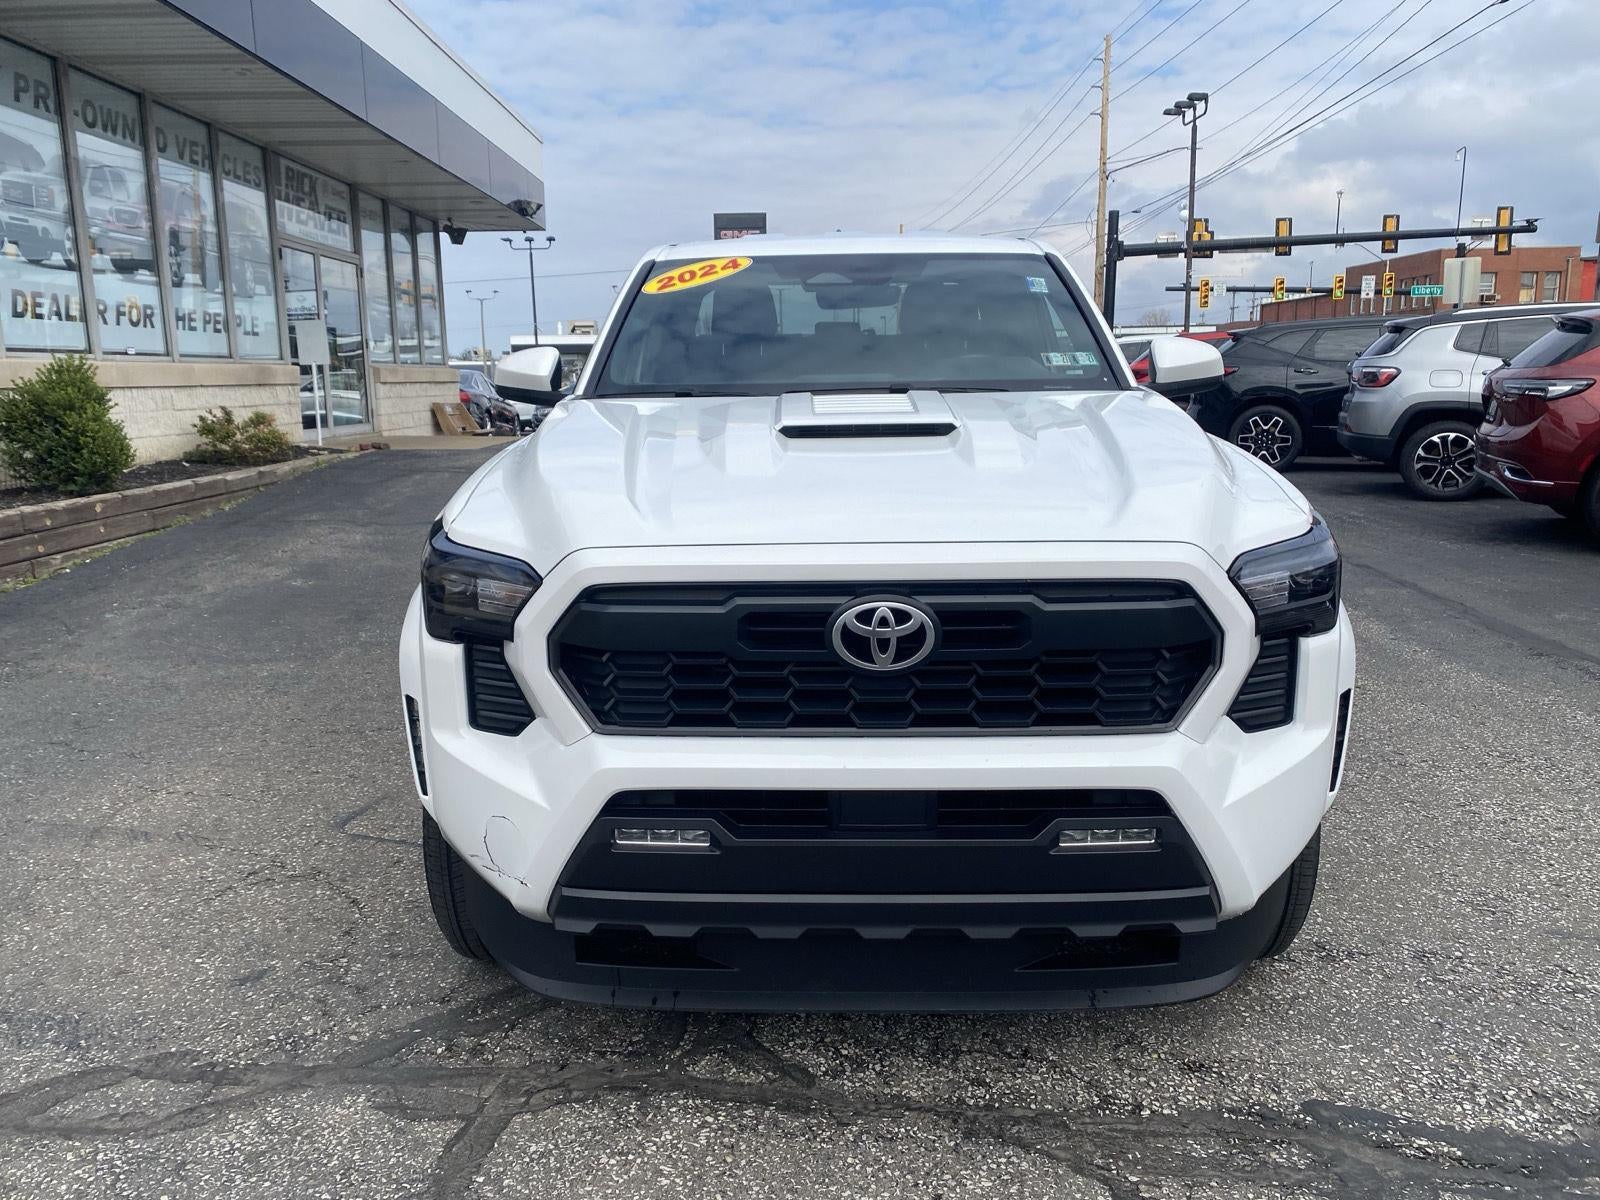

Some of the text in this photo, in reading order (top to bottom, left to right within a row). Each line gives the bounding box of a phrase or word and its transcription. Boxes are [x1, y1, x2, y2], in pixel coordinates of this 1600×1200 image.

[174, 134, 262, 188] VEHCLES
[656, 258, 742, 292] 2024
[1415, 286, 1442, 295] Liberty
[11, 288, 108, 326] DEALR
[115, 299, 155, 329] FOR
